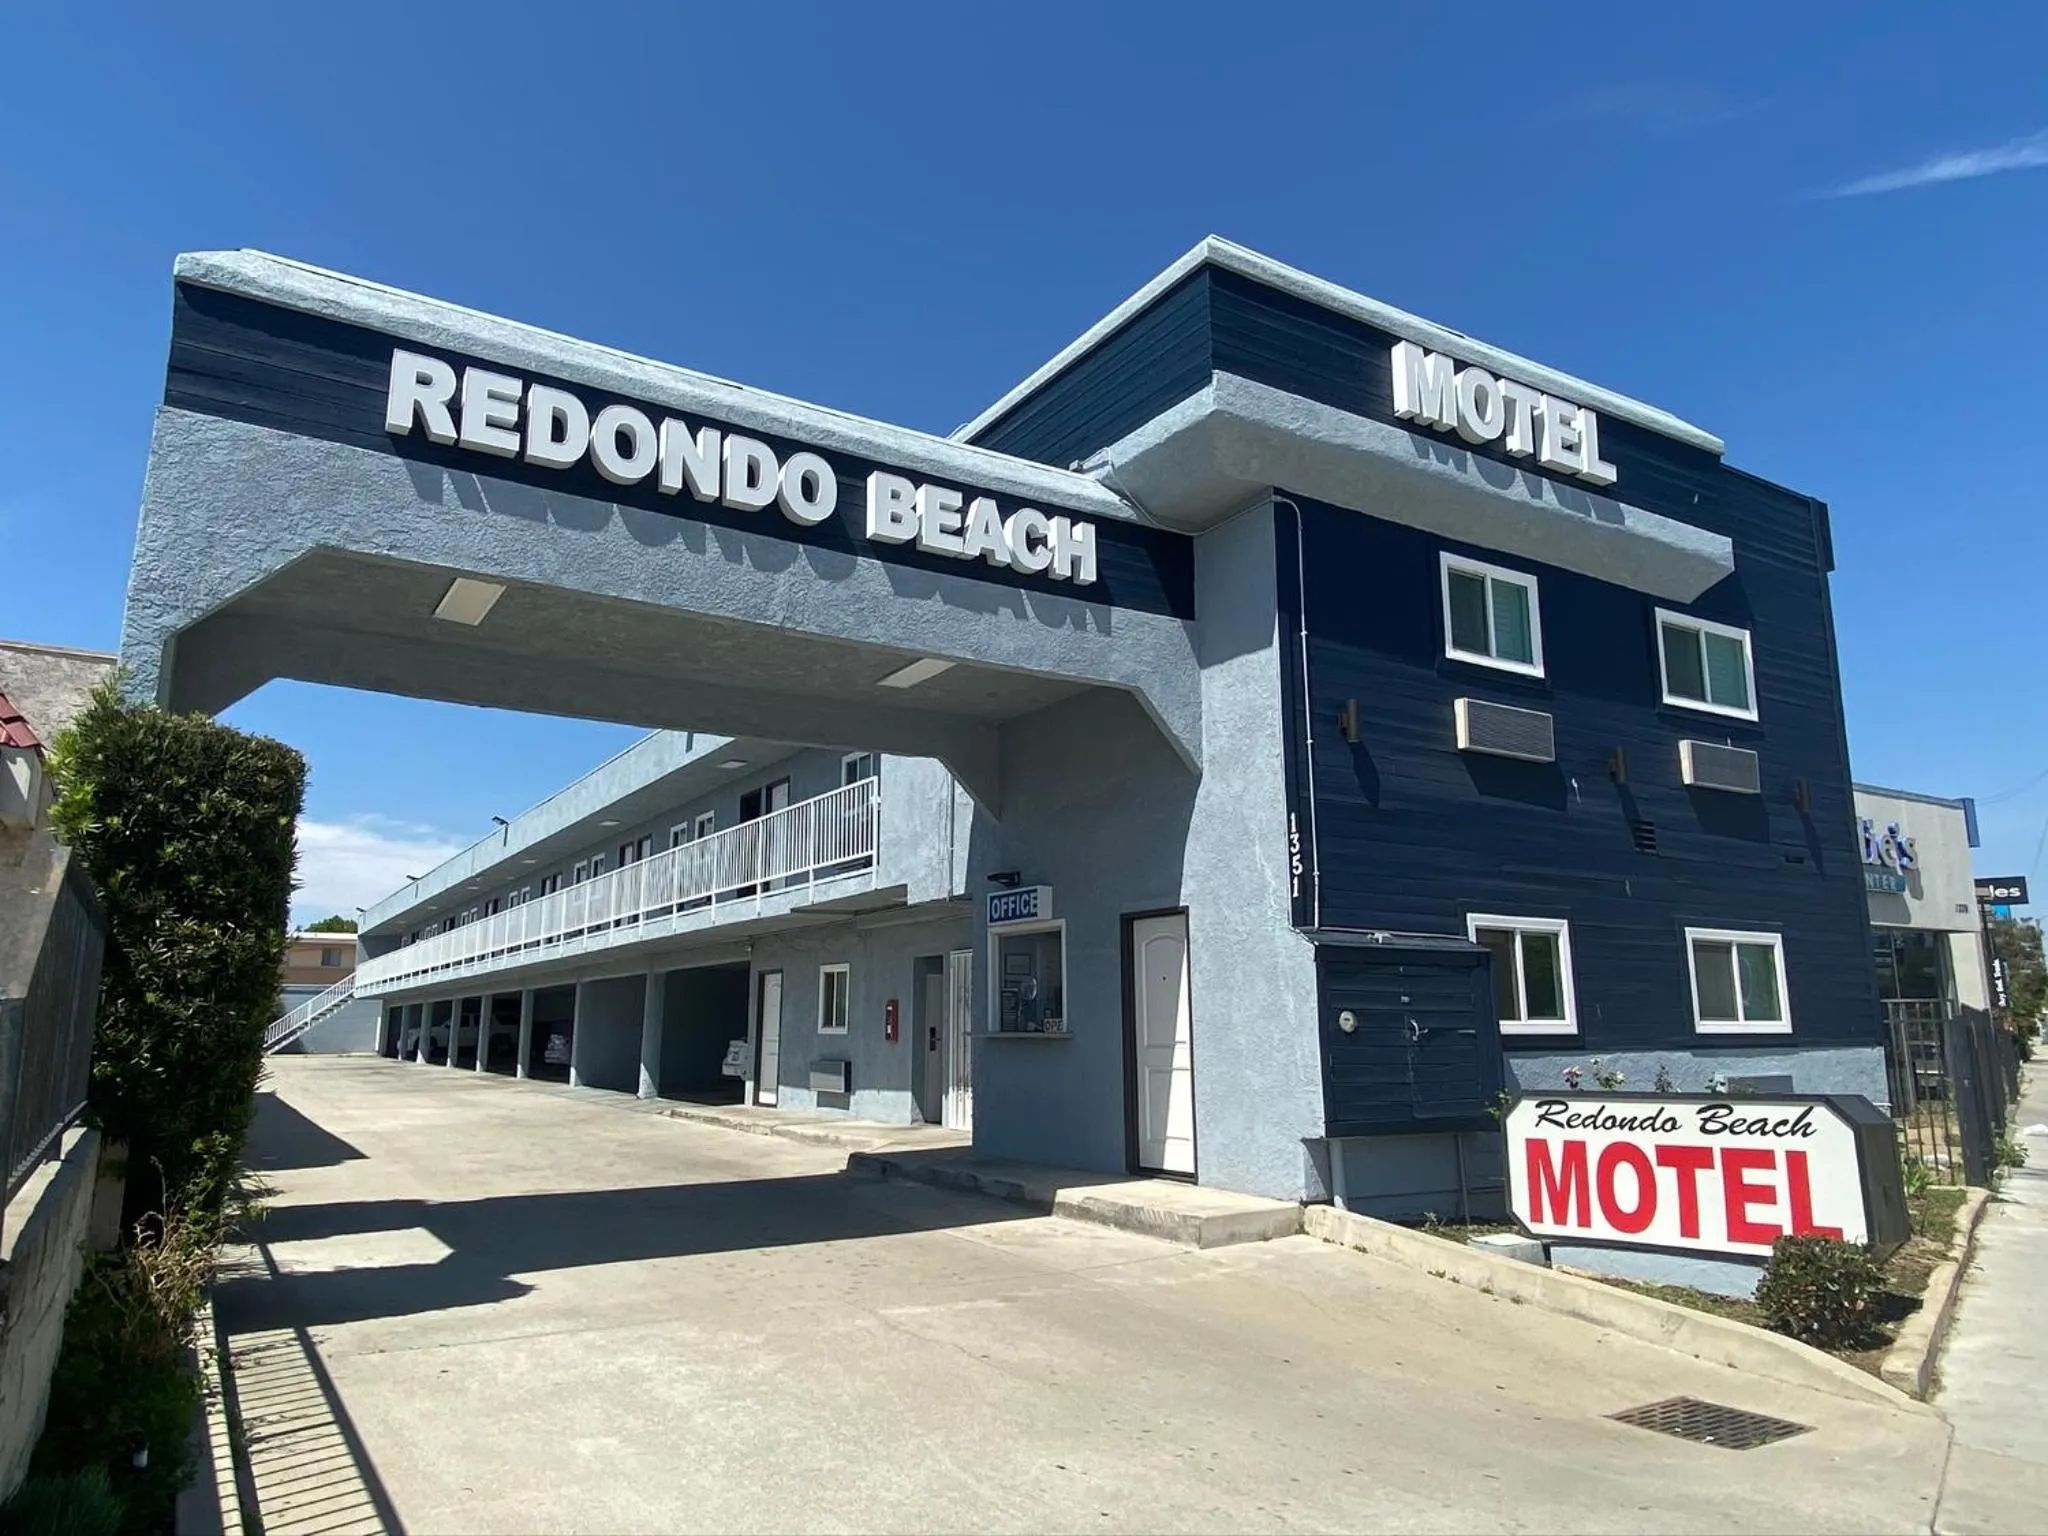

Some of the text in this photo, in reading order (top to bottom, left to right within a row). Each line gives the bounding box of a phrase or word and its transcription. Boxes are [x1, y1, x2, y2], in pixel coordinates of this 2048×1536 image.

[1391, 339, 1617, 487] MOTEL
[385, 347, 1097, 586] REDONDO BEACH
[1289, 811, 1303, 898] 1351
[991, 892, 1038, 920] OFFICE
[1534, 1099, 1818, 1139] Redondo Beach
[1525, 1137, 1844, 1245] MOTEL
